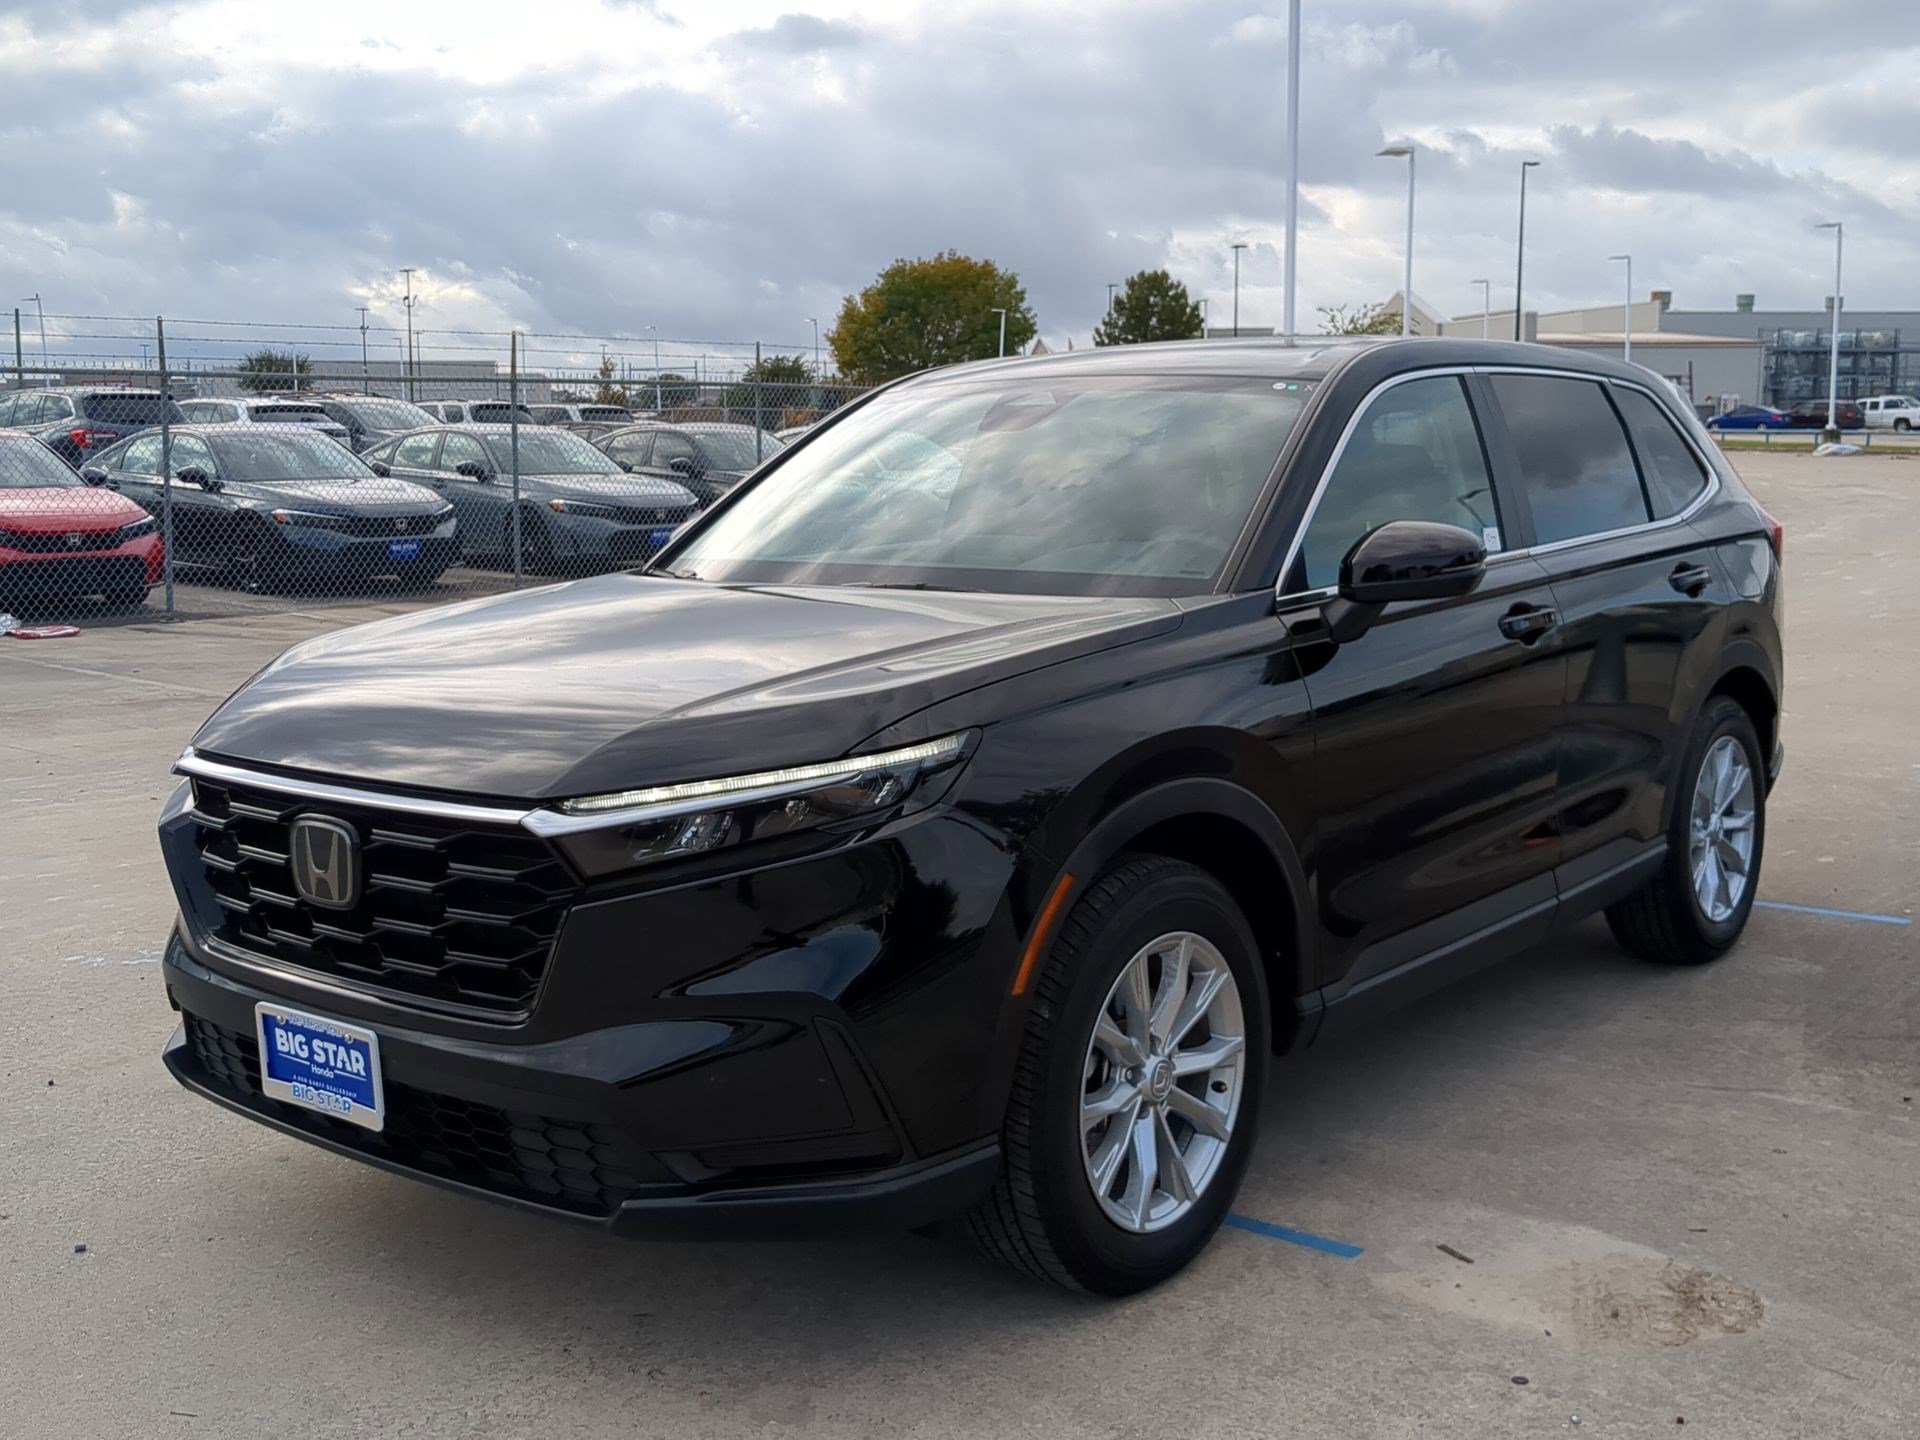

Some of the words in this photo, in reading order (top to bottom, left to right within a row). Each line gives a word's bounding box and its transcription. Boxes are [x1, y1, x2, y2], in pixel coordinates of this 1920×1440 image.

[274, 1027, 309, 1059] BIG
[312, 1038, 366, 1077] STAR
[311, 1063, 334, 1079] Honda
[292, 1083, 315, 1102] BIG
[317, 1090, 352, 1113] STAR
